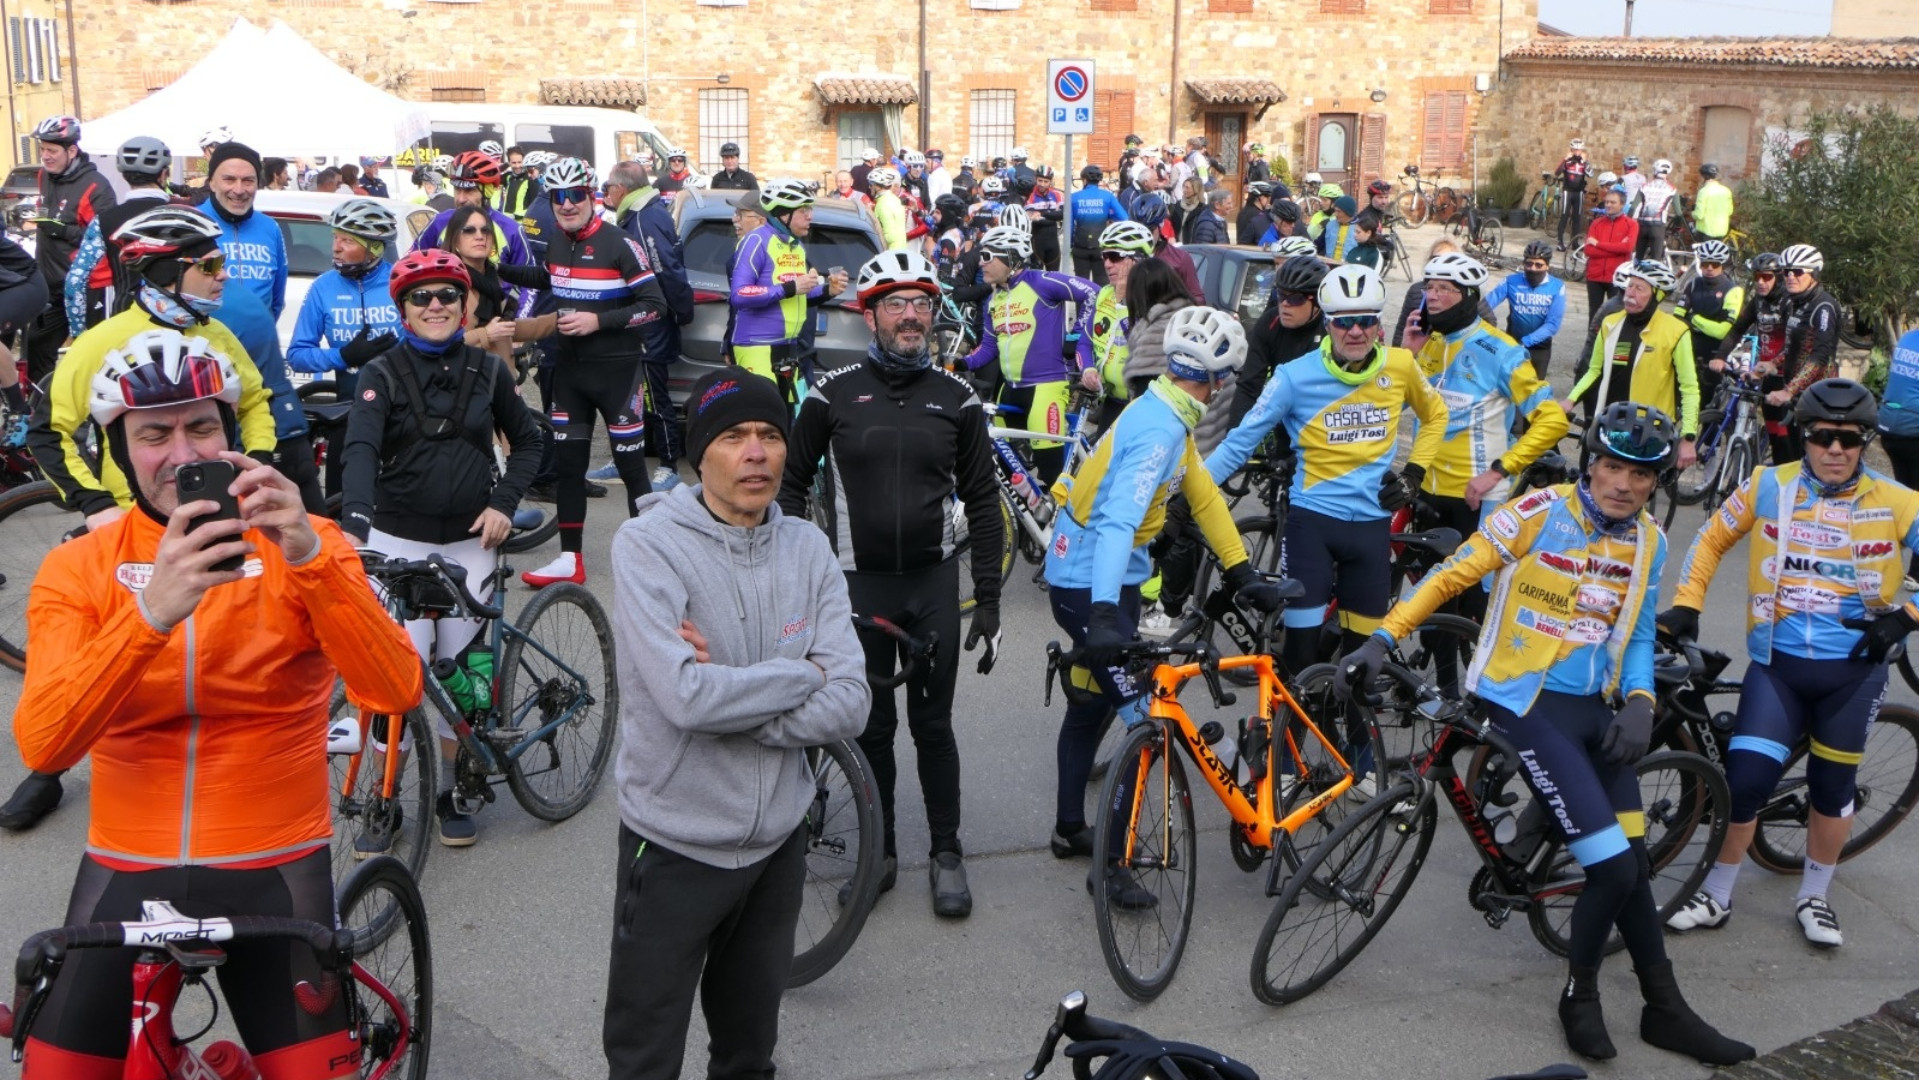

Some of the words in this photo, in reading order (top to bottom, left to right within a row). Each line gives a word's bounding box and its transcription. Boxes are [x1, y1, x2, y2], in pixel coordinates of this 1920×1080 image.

[1055, 109, 1064, 121] P
[1515, 292, 1553, 306] TURRIS
[331, 305, 398, 325] TURRIS
[1323, 408, 1390, 428] CASALESE
[1328, 429, 1359, 442] Luigi
[1361, 426, 1387, 438] Tosi
[1518, 582, 1569, 609] CARIPARMA
[1518, 748, 1559, 794] Luigi
[1547, 793, 1581, 836] Tosi
